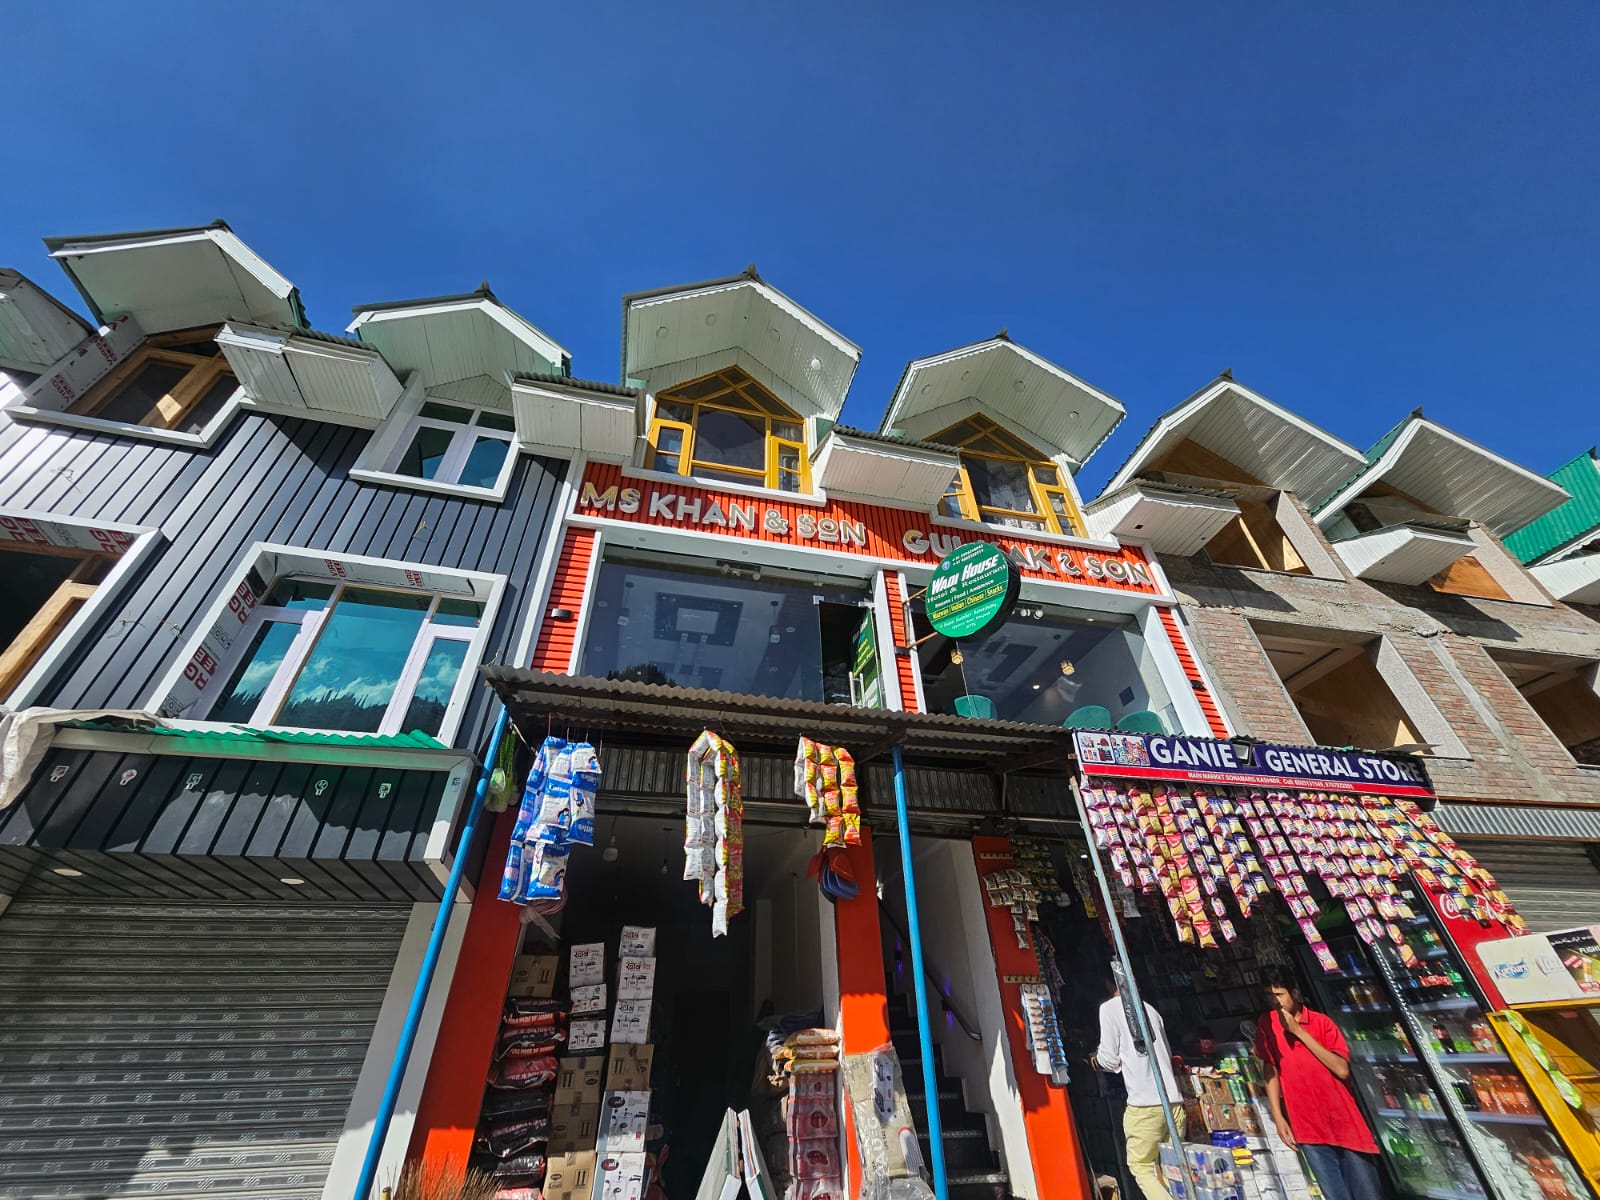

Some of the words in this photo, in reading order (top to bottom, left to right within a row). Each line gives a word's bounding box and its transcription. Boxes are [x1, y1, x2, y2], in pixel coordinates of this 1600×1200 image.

[581, 482, 640, 513] MS
[650, 491, 754, 530] KHAN
[764, 509, 788, 534] &
[797, 514, 866, 546] SON
[927, 590, 948, 603] Hotel
[962, 564, 1006, 587] Restaurant
[962, 554, 999, 581] HOUSE
[1057, 552, 1081, 576] &
[1084, 556, 1152, 586] SON
[1149, 738, 1237, 768] GANIE
[1265, 750, 1360, 778] GENERAL
[1361, 756, 1423, 783] STORE
